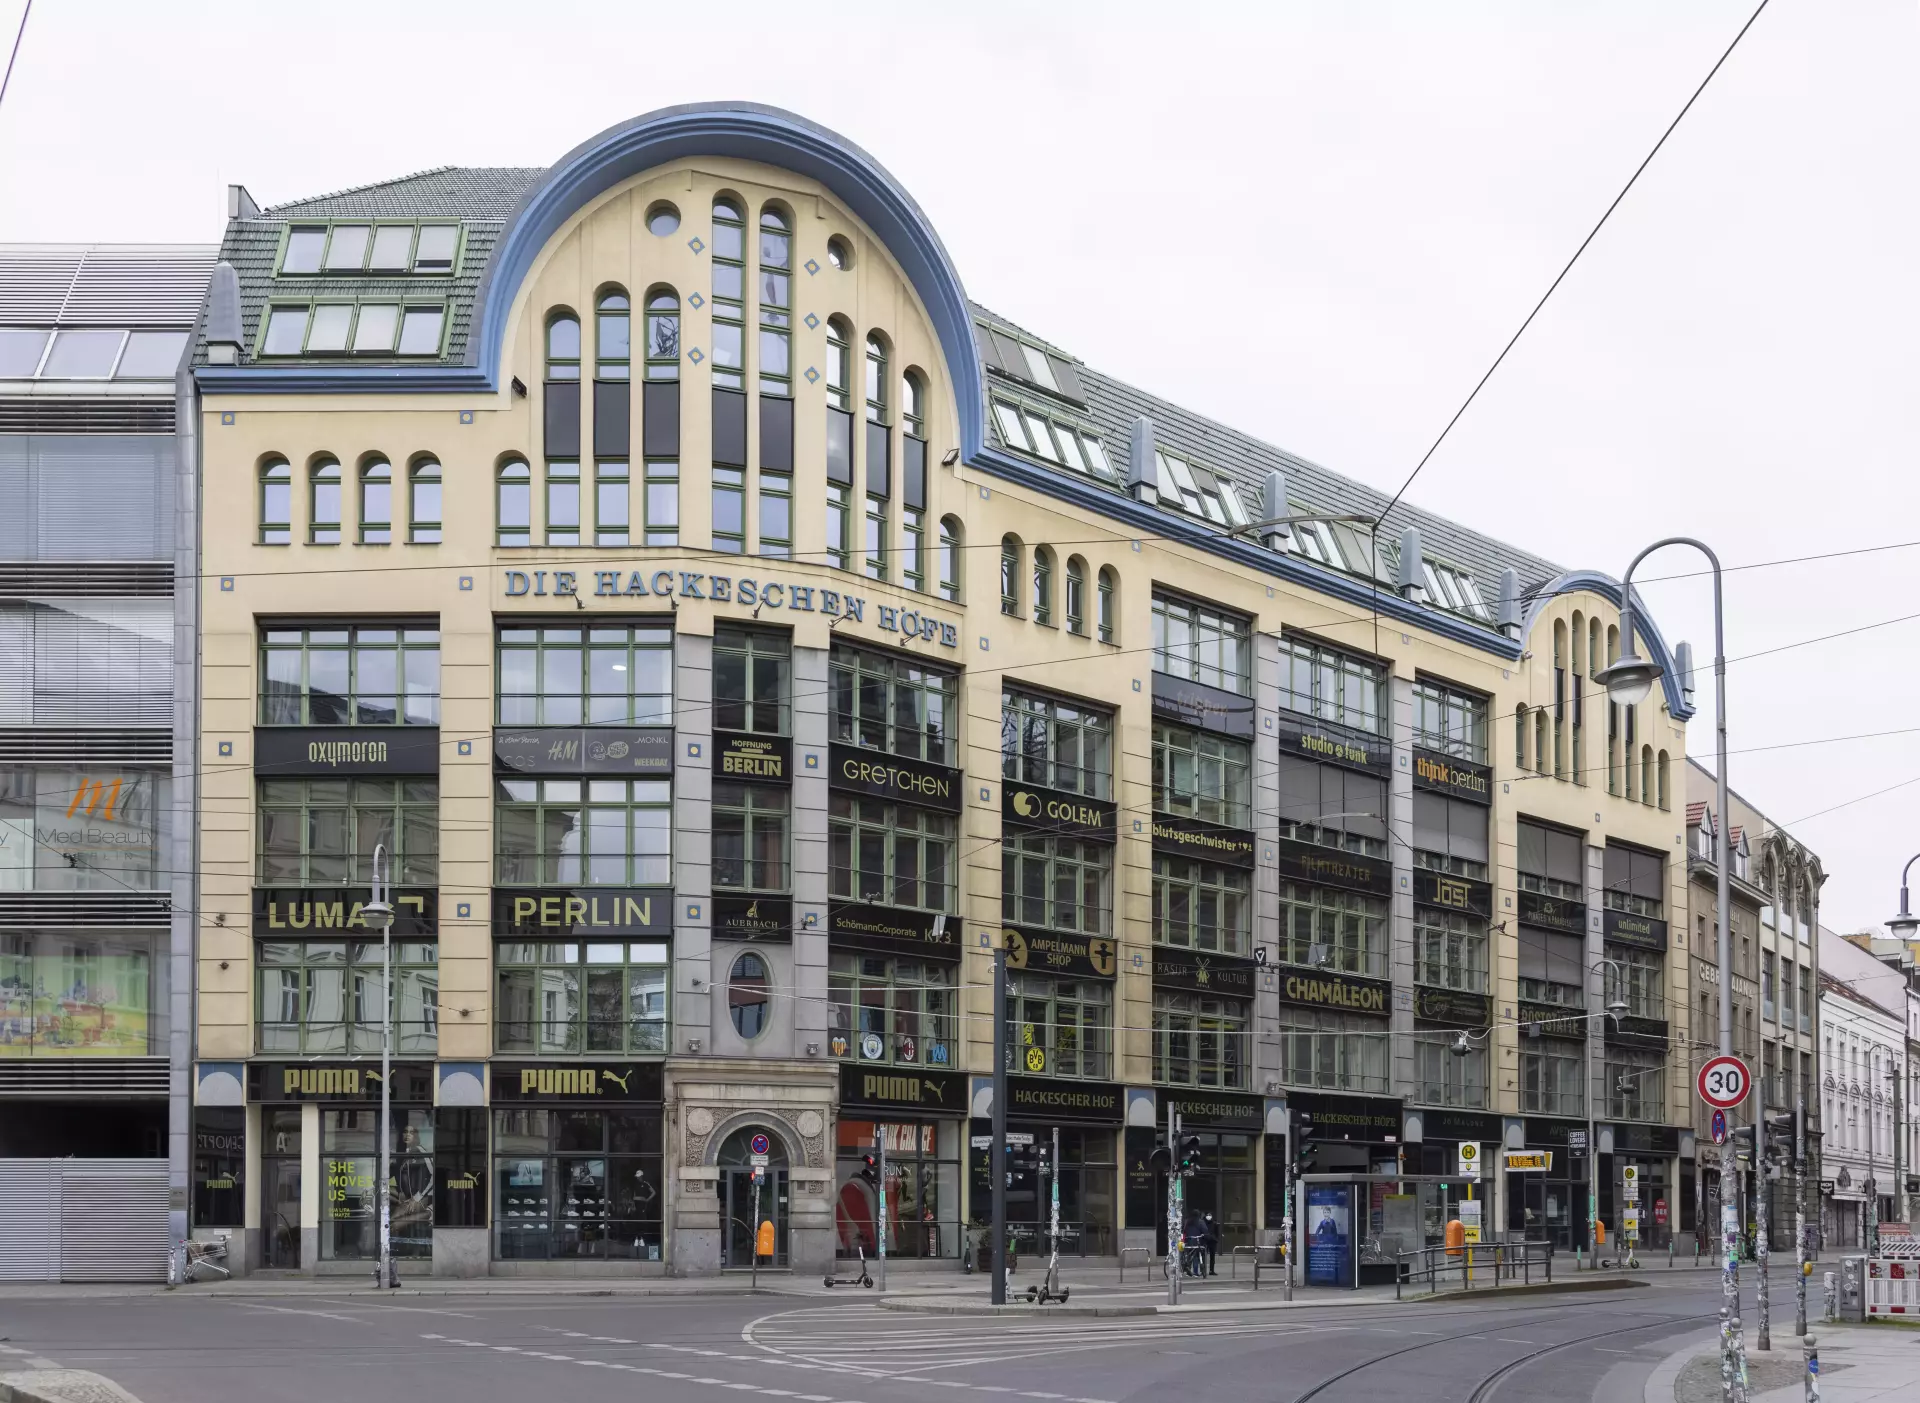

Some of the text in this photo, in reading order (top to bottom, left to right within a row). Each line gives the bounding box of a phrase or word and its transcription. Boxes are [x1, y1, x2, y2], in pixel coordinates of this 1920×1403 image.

[505, 570, 958, 648] DIE HACKESCHEN HÖFE
[634, 736, 669, 744] MONKI
[731, 739, 772, 750] HOFFNUNG
[1301, 733, 1368, 765] studio funk
[308, 741, 387, 767] oxymoron
[503, 755, 536, 767] COS
[548, 740, 579, 763] H&M
[634, 758, 668, 767] WEEKDAY
[723, 757, 782, 777] BERLIN
[1449, 766, 1486, 793] berlin
[1047, 800, 1102, 828] GOLEM
[37, 828, 157, 847] Med Beauty
[1152, 825, 1236, 852] blutsgeschwister
[269, 902, 396, 929] LUMA
[514, 897, 651, 927] PERLIN
[726, 919, 783, 930] AUERBACH
[836, 917, 917, 937] SchömannCorporate
[1618, 918, 1650, 935] unlimited
[1031, 937, 1086, 956] AMPELMANN
[1047, 953, 1071, 967] SHOP
[1157, 963, 1188, 977] RASUR
[1217, 971, 1248, 985] KULTUR
[1029, 1049, 1043, 1065] BVB
[284, 1069, 359, 1094] PUMA
[521, 1069, 596, 1094] PUMA
[864, 1075, 920, 1101] PUMA
[1709, 1070, 1740, 1094] 30
[1015, 1089, 1116, 1109] HACKESCHER HOF
[1168, 1101, 1254, 1117] ACKESCHER HOF
[1312, 1112, 1397, 1128] HACKESCHEN HÖFE
[329, 1161, 355, 1173] SHE
[206, 1179, 233, 1189] PUMA
[328, 1175, 373, 1188] MOVES
[447, 1179, 474, 1190] PUMA
[328, 1189, 346, 1201] US
